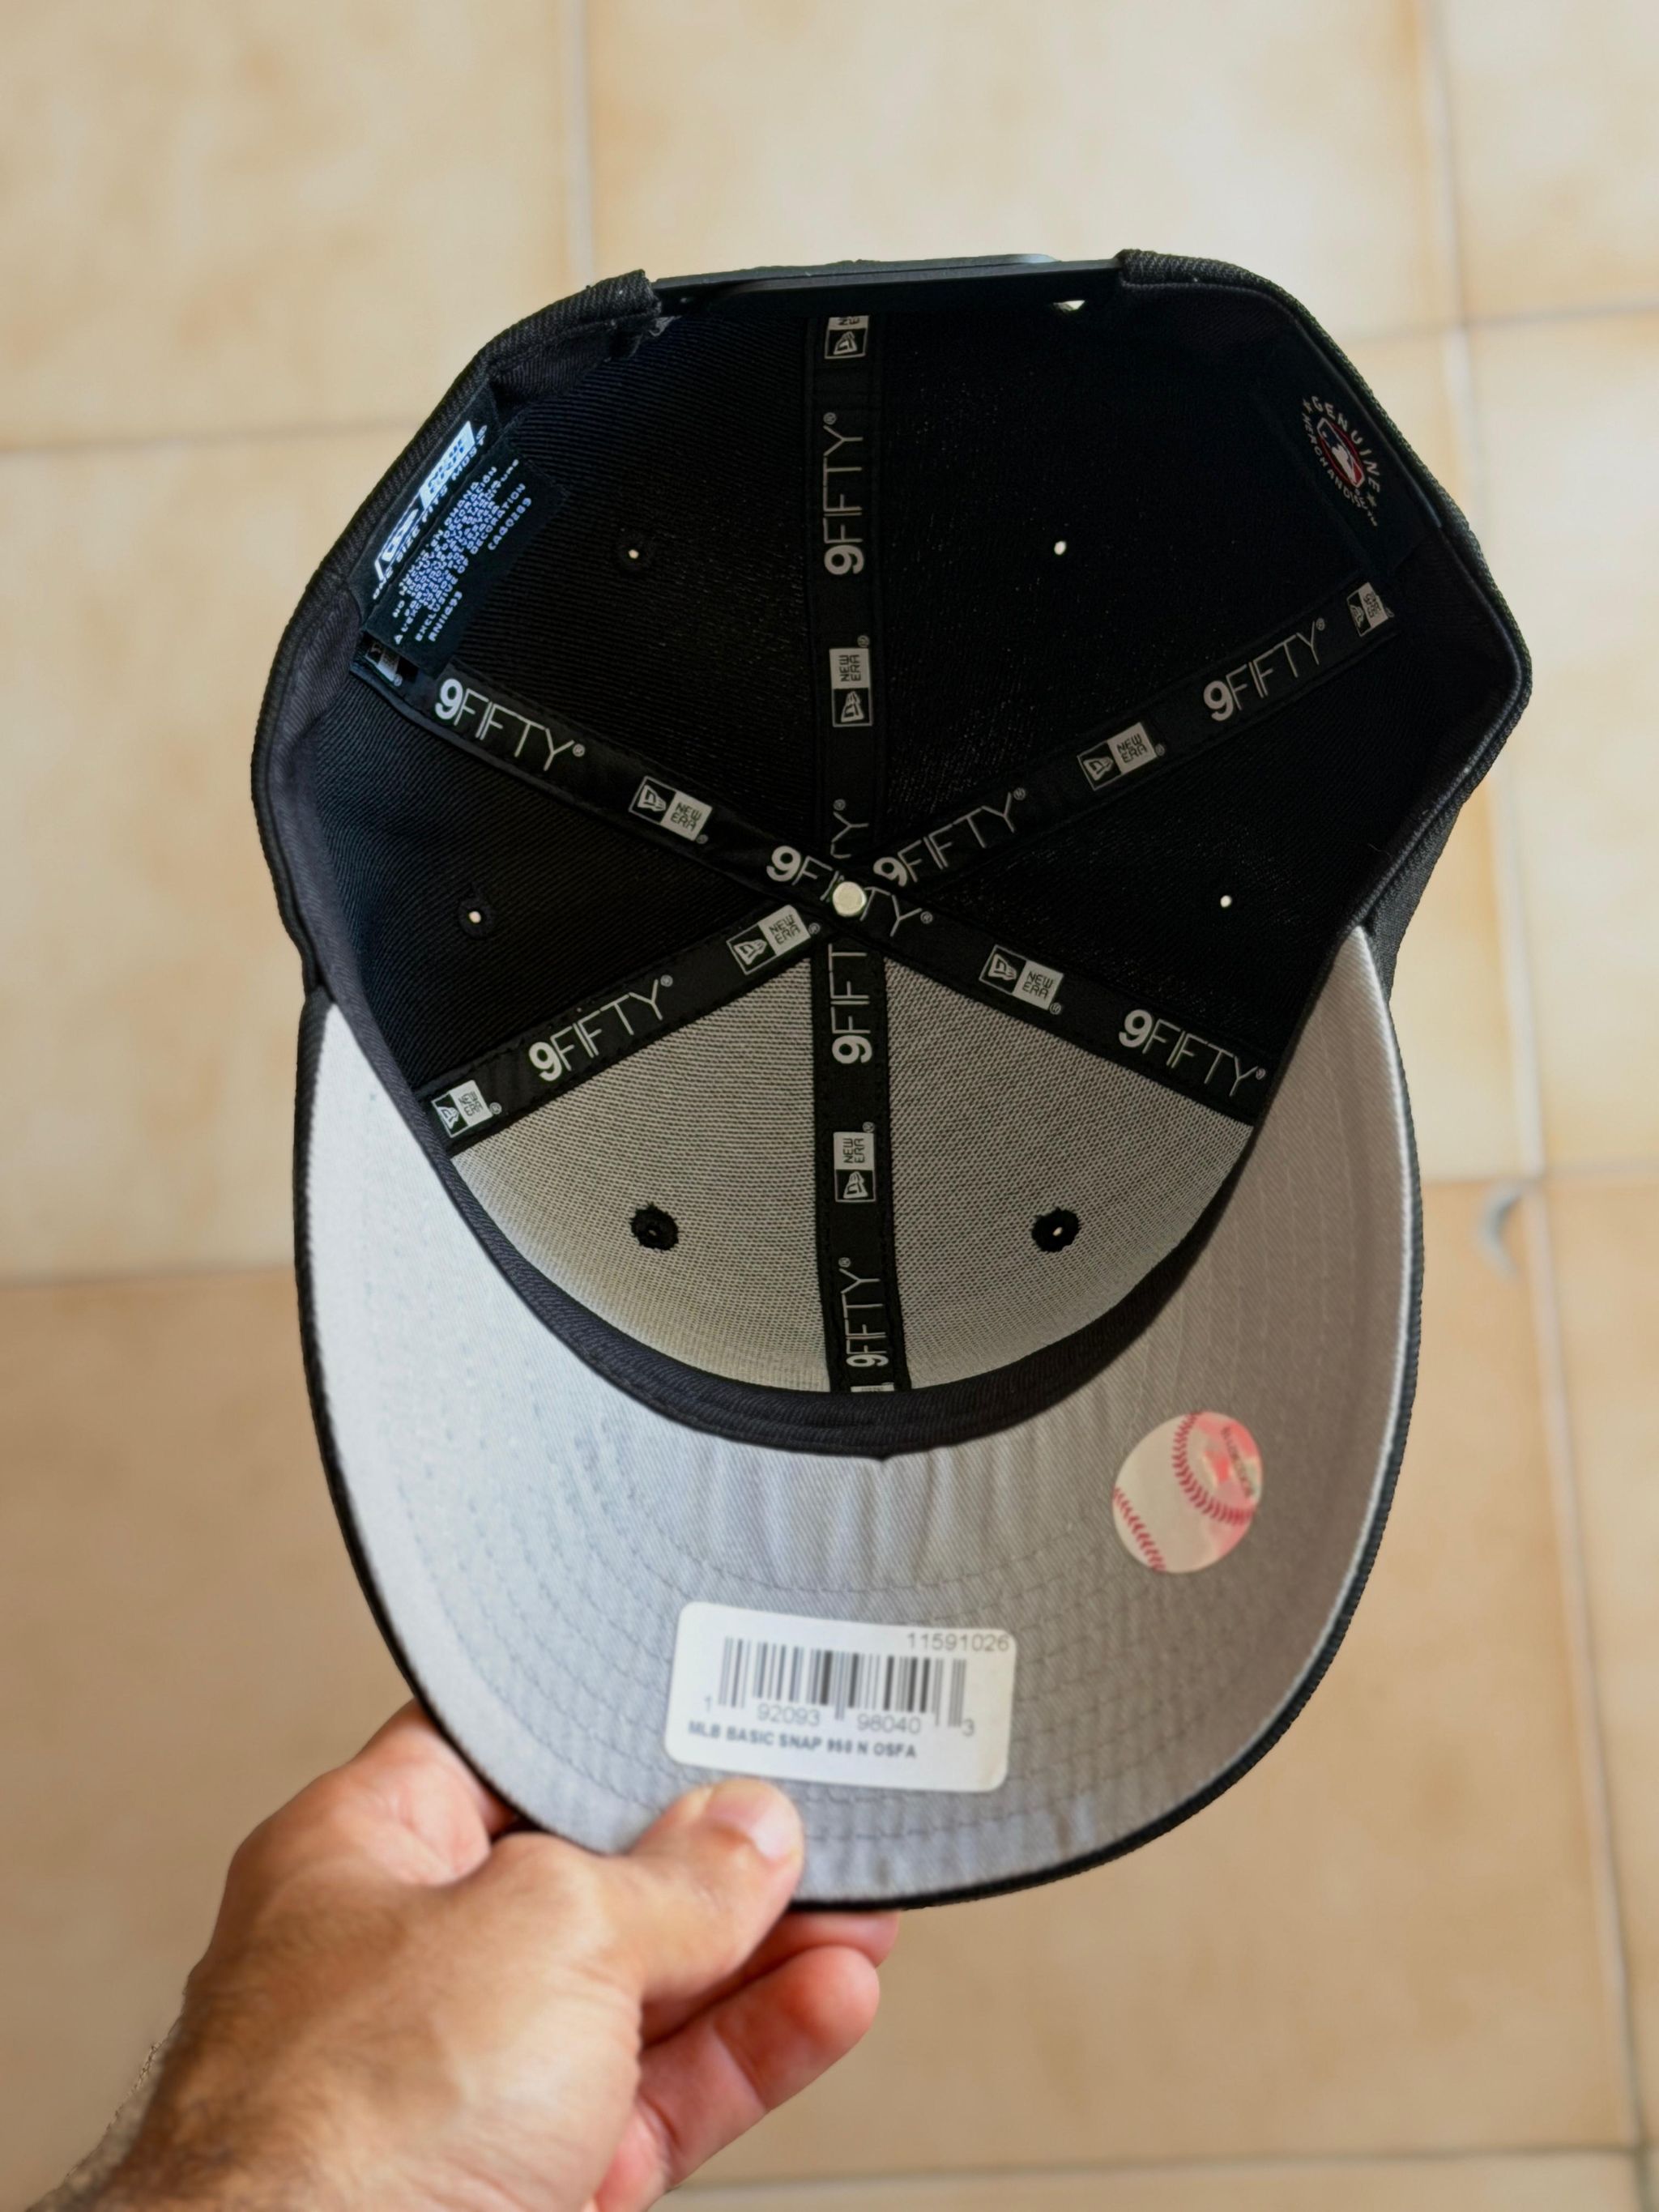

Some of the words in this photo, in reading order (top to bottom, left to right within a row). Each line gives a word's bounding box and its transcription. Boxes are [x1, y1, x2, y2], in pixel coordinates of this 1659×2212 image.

[1311, 395, 1380, 492] GENUINE
[394, 525, 420, 562] SIZE
[420, 484, 448, 521] FITS
[450, 434, 484, 479] MOST
[823, 424, 864, 575] 9FIFTY
[414, 576, 458, 640] EXCLUSIVE
[470, 482, 526, 555] DECORATION
[391, 599, 405, 616] NO
[839, 654, 850, 682] NEW
[850, 654, 861, 681] ERA
[1203, 620, 1320, 721] 9FIFTY
[434, 678, 575, 771] 9FIFTY
[1116, 733, 1142, 753] NEW
[1121, 744, 1148, 763] ERA
[671, 812, 697, 832] ERA
[676, 803, 702, 820] NEW
[872, 792, 1015, 887] 9FIFTY
[766, 845, 923, 937] 9FITY
[769, 914, 795, 935] NEW
[774, 924, 800, 944] ERA
[1022, 982, 1048, 1000] ERA
[1027, 971, 1053, 989] NEW
[828, 944, 872, 1064] 9FIFT
[528, 978, 663, 1082] 9FIFTY
[1118, 1008, 1260, 1097] 9FIFTY
[843, 1138, 853, 1163] NEW
[854, 1138, 864, 1163] ERA
[838, 1268, 889, 1368] 9FIFTY
[907, 1631, 1009, 1652] 11591026
[757, 1703, 821, 1727] 92093
[857, 1712, 922, 1734] 98040
[962, 1718, 975, 1737] 3
[688, 1720, 721, 1739] MLB
[727, 1725, 774, 1746] BASIC
[778, 1732, 822, 1751] SNAP
[873, 1741, 917, 1758] OSFA
